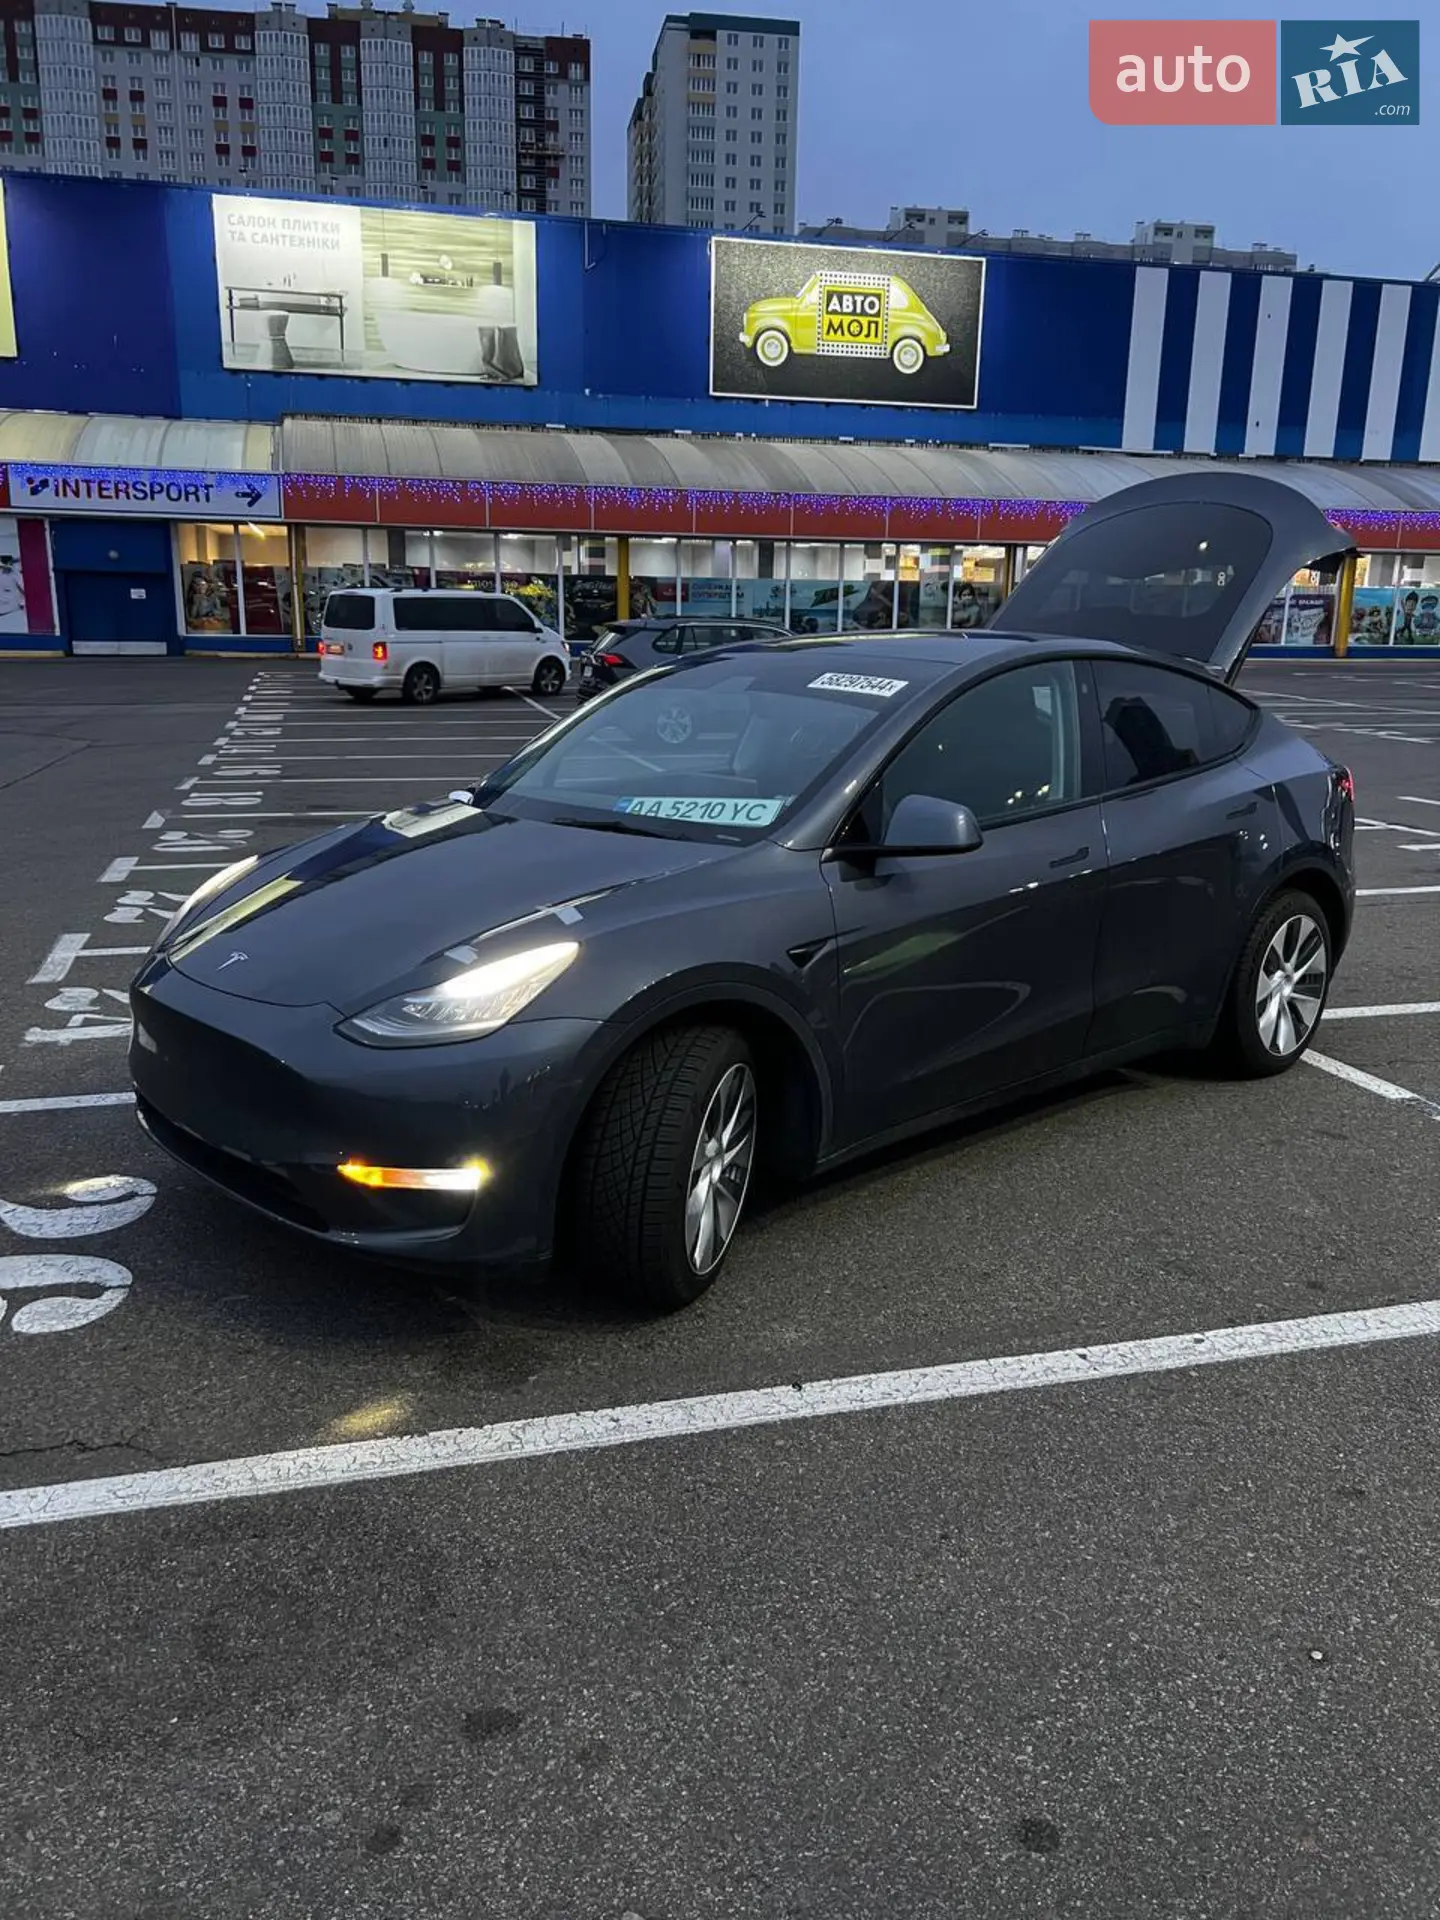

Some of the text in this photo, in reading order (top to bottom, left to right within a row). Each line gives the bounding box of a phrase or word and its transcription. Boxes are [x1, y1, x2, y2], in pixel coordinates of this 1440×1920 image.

[227, 213, 340, 235] САЛОН ПЛИТКИ
[228, 229, 340, 251] ТА САНТЕХНІКИ
[827, 294, 880, 315] АВТО
[826, 318, 879, 339] МОЛ
[53, 477, 214, 503] INTERSPORT
[630, 801, 767, 822] AA 5210 YC
